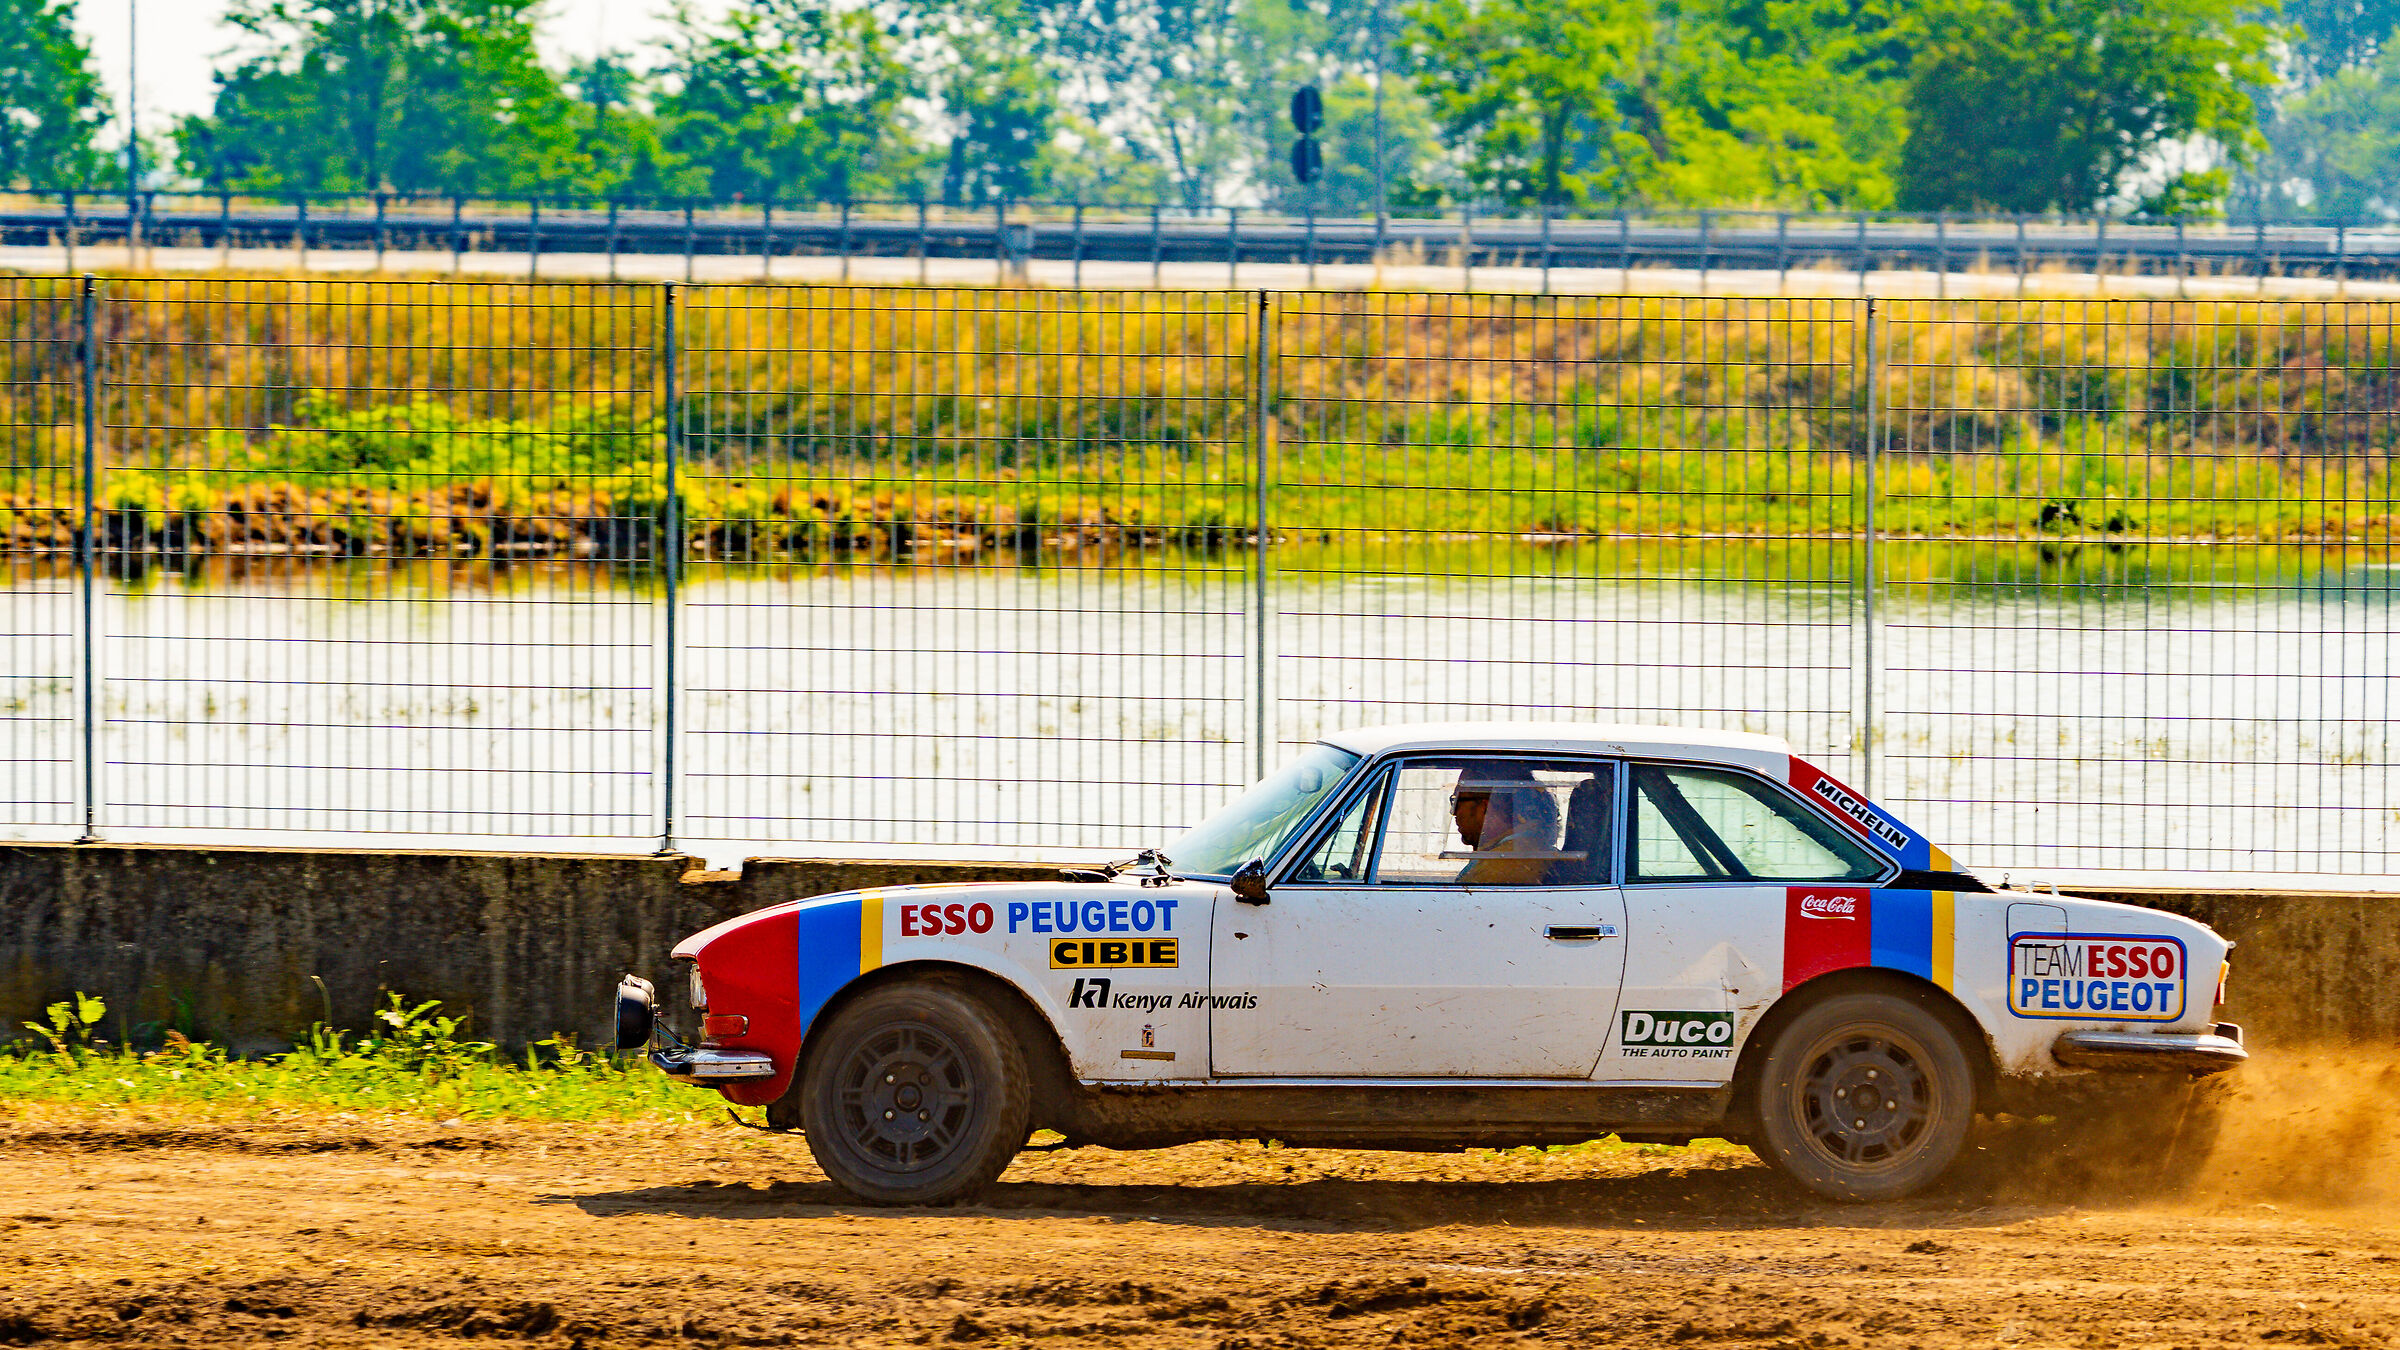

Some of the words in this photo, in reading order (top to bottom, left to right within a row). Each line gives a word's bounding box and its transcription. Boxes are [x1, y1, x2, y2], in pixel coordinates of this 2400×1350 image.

[1815, 780, 1907, 848] MICHELIN
[901, 902, 994, 937] ESSO
[1008, 900, 1178, 934] PEUGEOT
[2019, 944, 2082, 977] TEAM
[2088, 945, 2175, 979] ESSO
[1112, 992, 1173, 1014] Kenya
[2021, 979, 2175, 1012] PEUGEOT
[1624, 1013, 1732, 1043] Duco
[1622, 1048, 1649, 1057] THE
[1651, 1049, 1688, 1058] AUTO
[1692, 1049, 1733, 1058] PAINT
